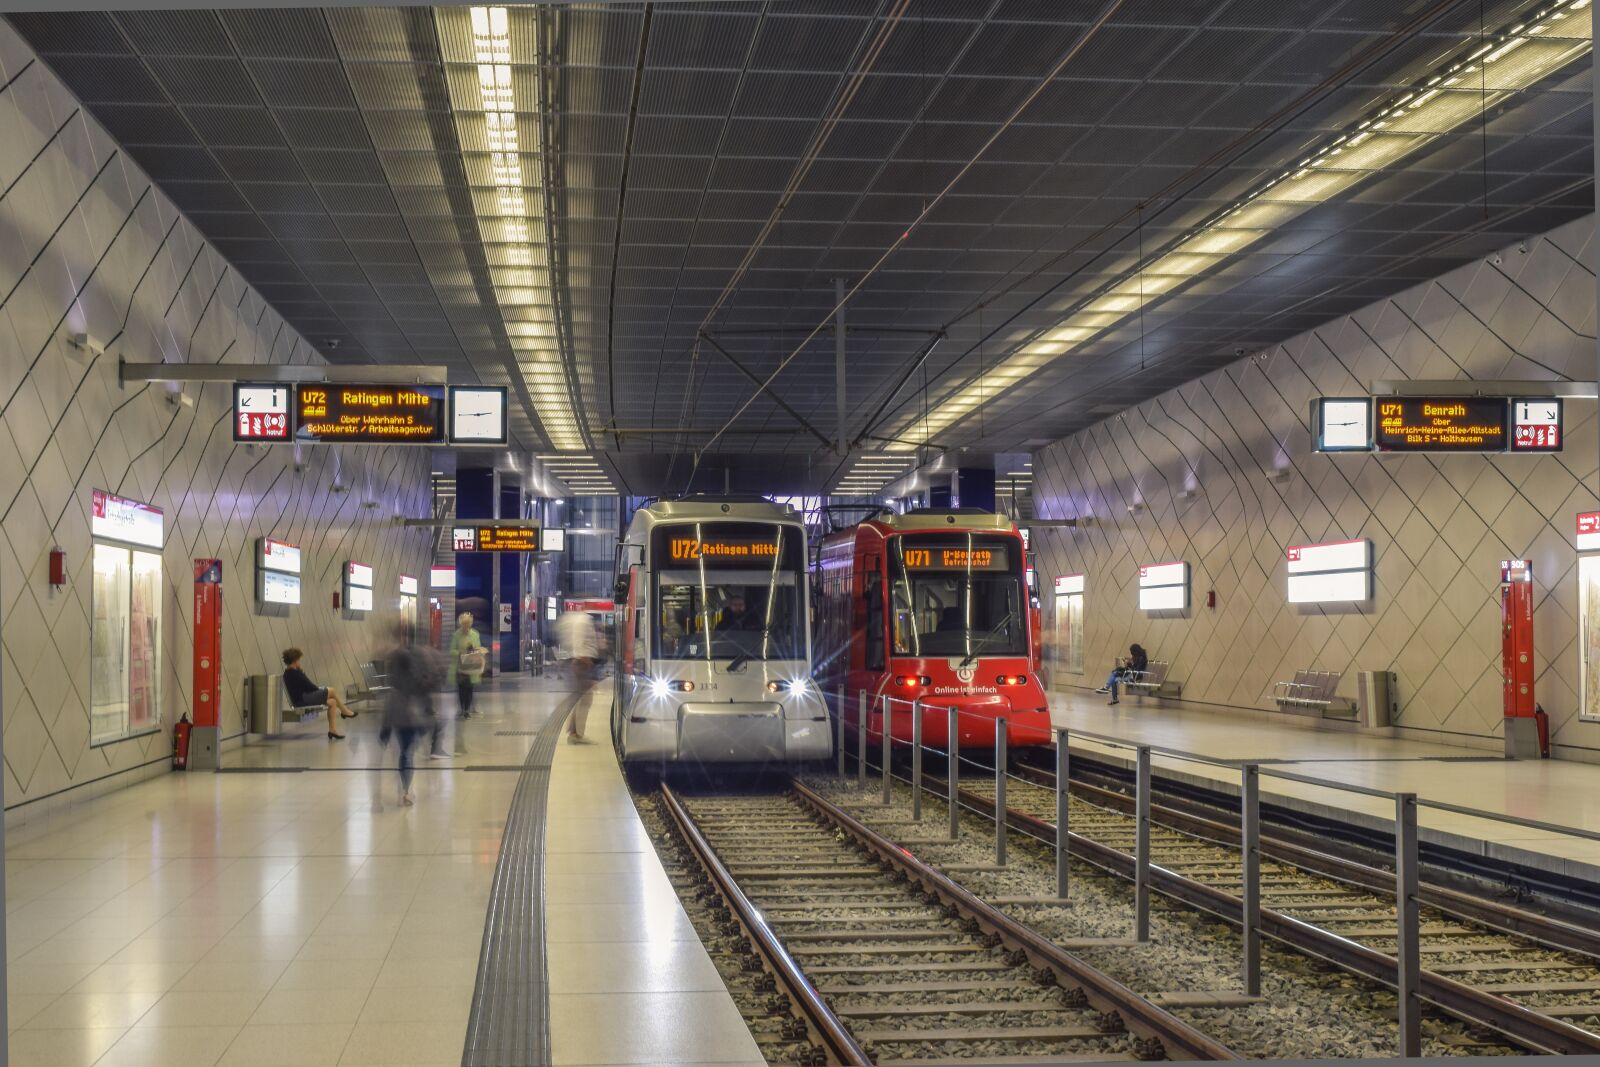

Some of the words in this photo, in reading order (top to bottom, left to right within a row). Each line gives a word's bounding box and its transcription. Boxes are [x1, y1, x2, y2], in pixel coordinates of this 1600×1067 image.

[304, 392, 325, 403] U72
[343, 392, 392, 407] Ratingen
[398, 393, 429, 404] Mitte
[1382, 405, 1402, 415] U71
[1424, 405, 1465, 415] Benrath
[364, 416, 404, 424] Wehrhahn
[407, 416, 413, 424] S
[308, 425, 358, 433] Schlüterstr.
[369, 425, 432, 434] Arbeitsagentur
[672, 539, 699, 558] U72
[702, 544, 748, 555] Ratingen
[906, 550, 930, 566] U71
[1511, 560, 1524, 568] SOS
